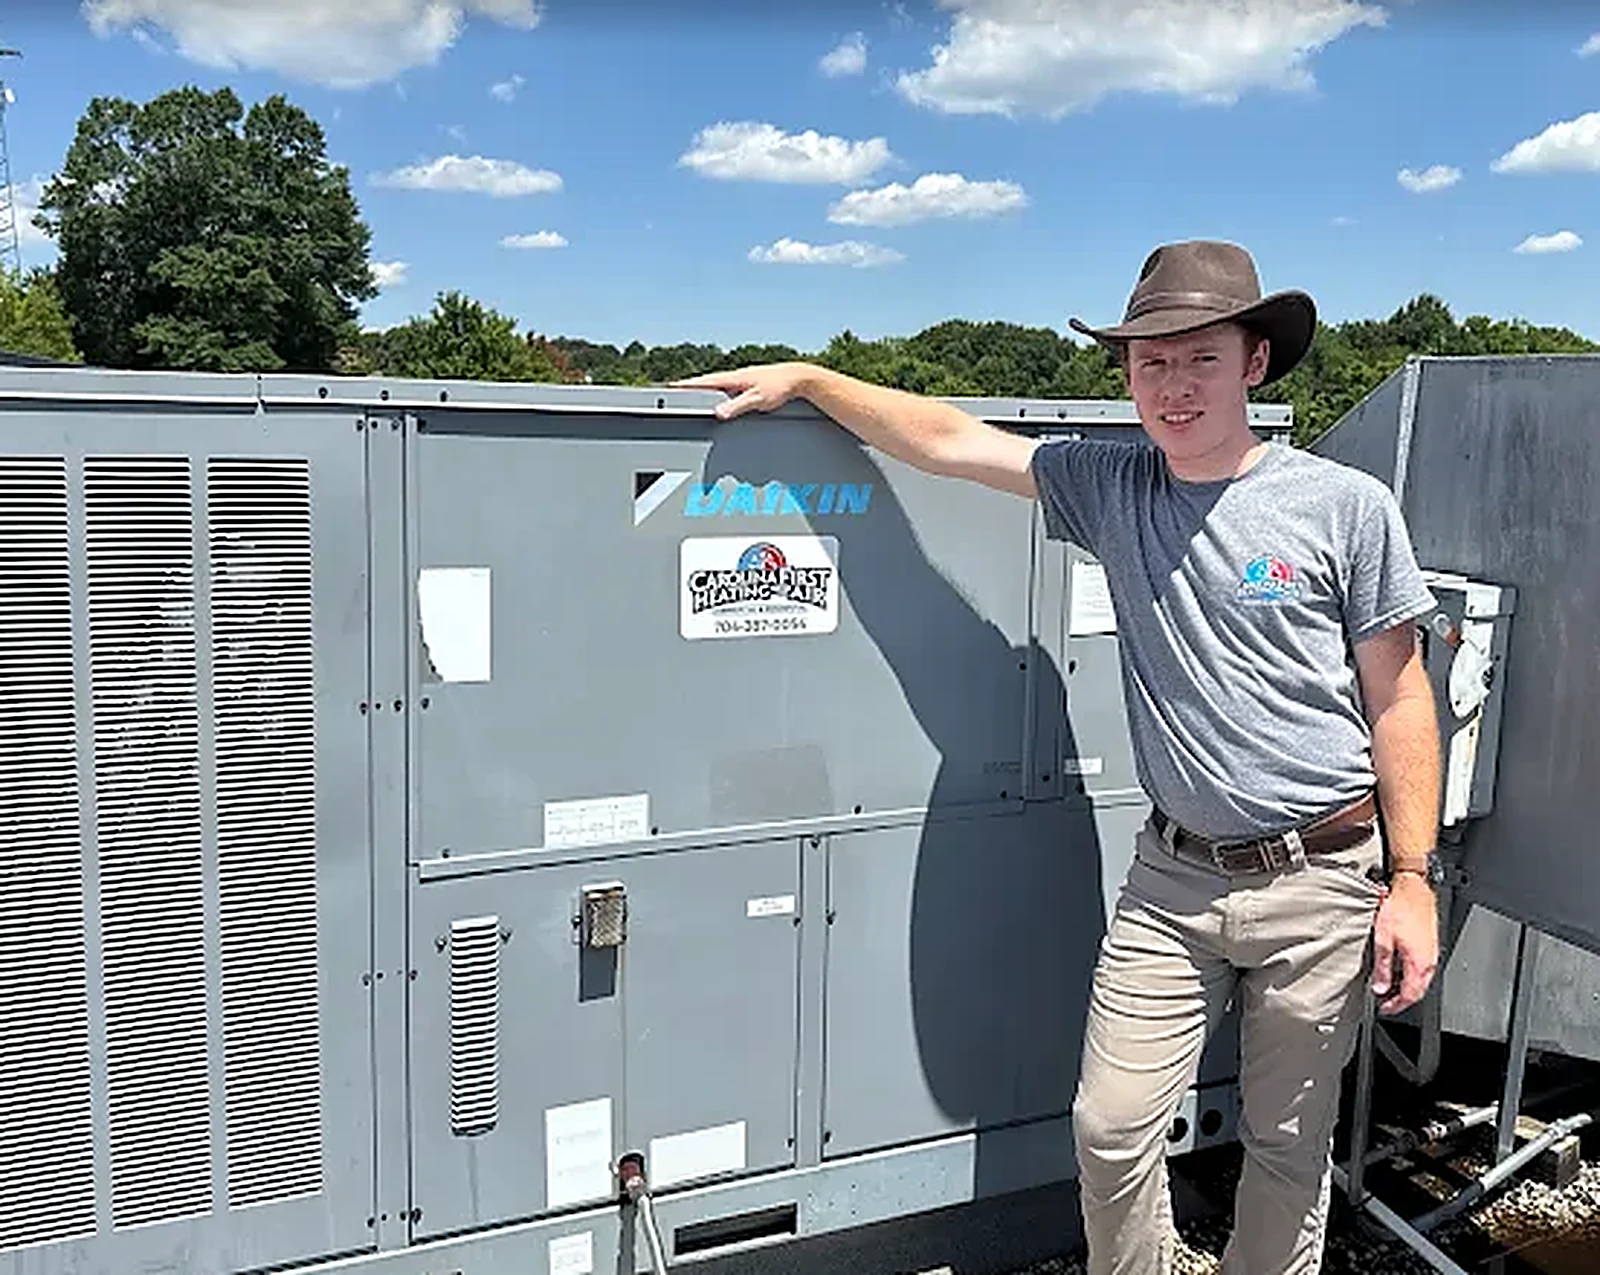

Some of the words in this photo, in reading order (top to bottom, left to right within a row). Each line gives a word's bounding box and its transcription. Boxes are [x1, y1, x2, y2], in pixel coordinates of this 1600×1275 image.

[684, 483, 873, 517] DAIKIN
[689, 569, 780, 593] CAROLINA
[779, 567, 832, 588] FIRST
[693, 584, 771, 613] HEATING
[788, 586, 828, 610] AIR
